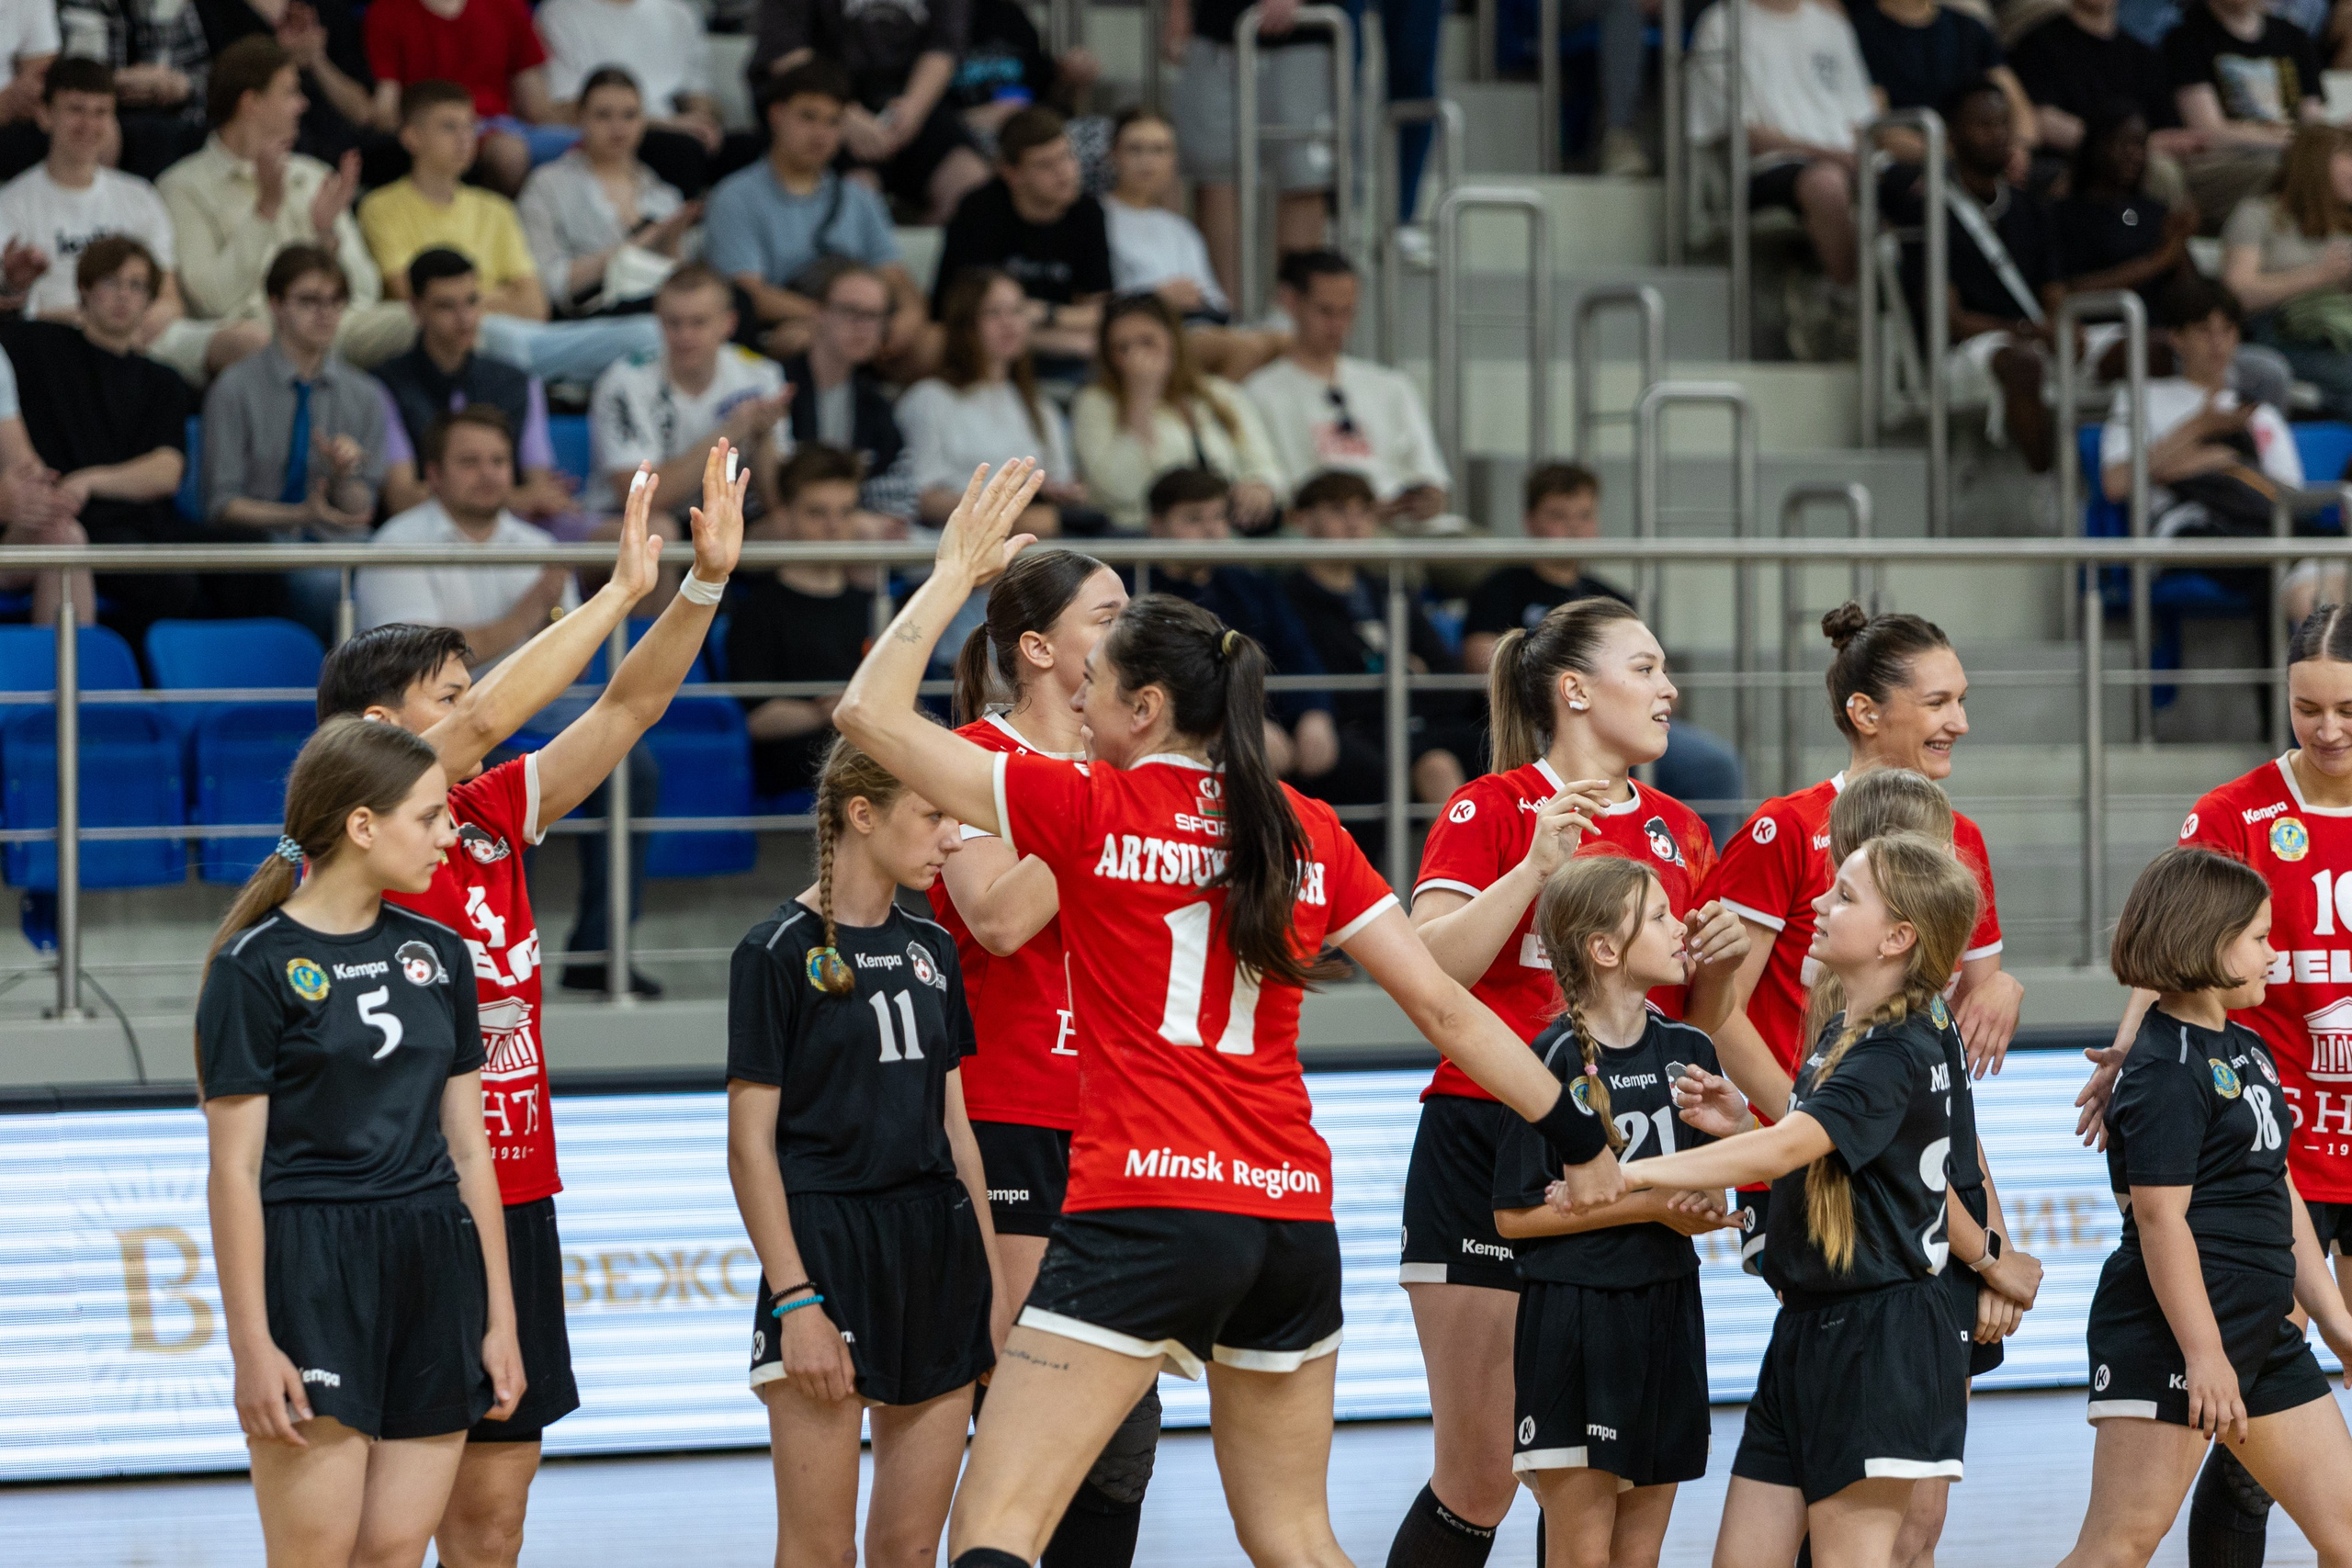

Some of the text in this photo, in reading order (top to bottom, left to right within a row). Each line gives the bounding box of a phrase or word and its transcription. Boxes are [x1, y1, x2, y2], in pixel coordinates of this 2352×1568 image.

[2242, 801, 2289, 825] Kempa
[332, 960, 390, 980] Kempa
[854, 952, 903, 971] Kempa
[356, 985, 404, 1060] 5
[868, 988, 925, 1063] 11
[1610, 1073, 1657, 1090] Kempa
[2243, 1084, 2282, 1152] 18
[1612, 1105, 1677, 1165] 21
[1125, 1146, 1321, 1200] Minsk Region
[986, 1189, 1030, 1205] empa
[300, 1367, 341, 1388] empa
[1587, 1423, 1617, 1442] mpa
